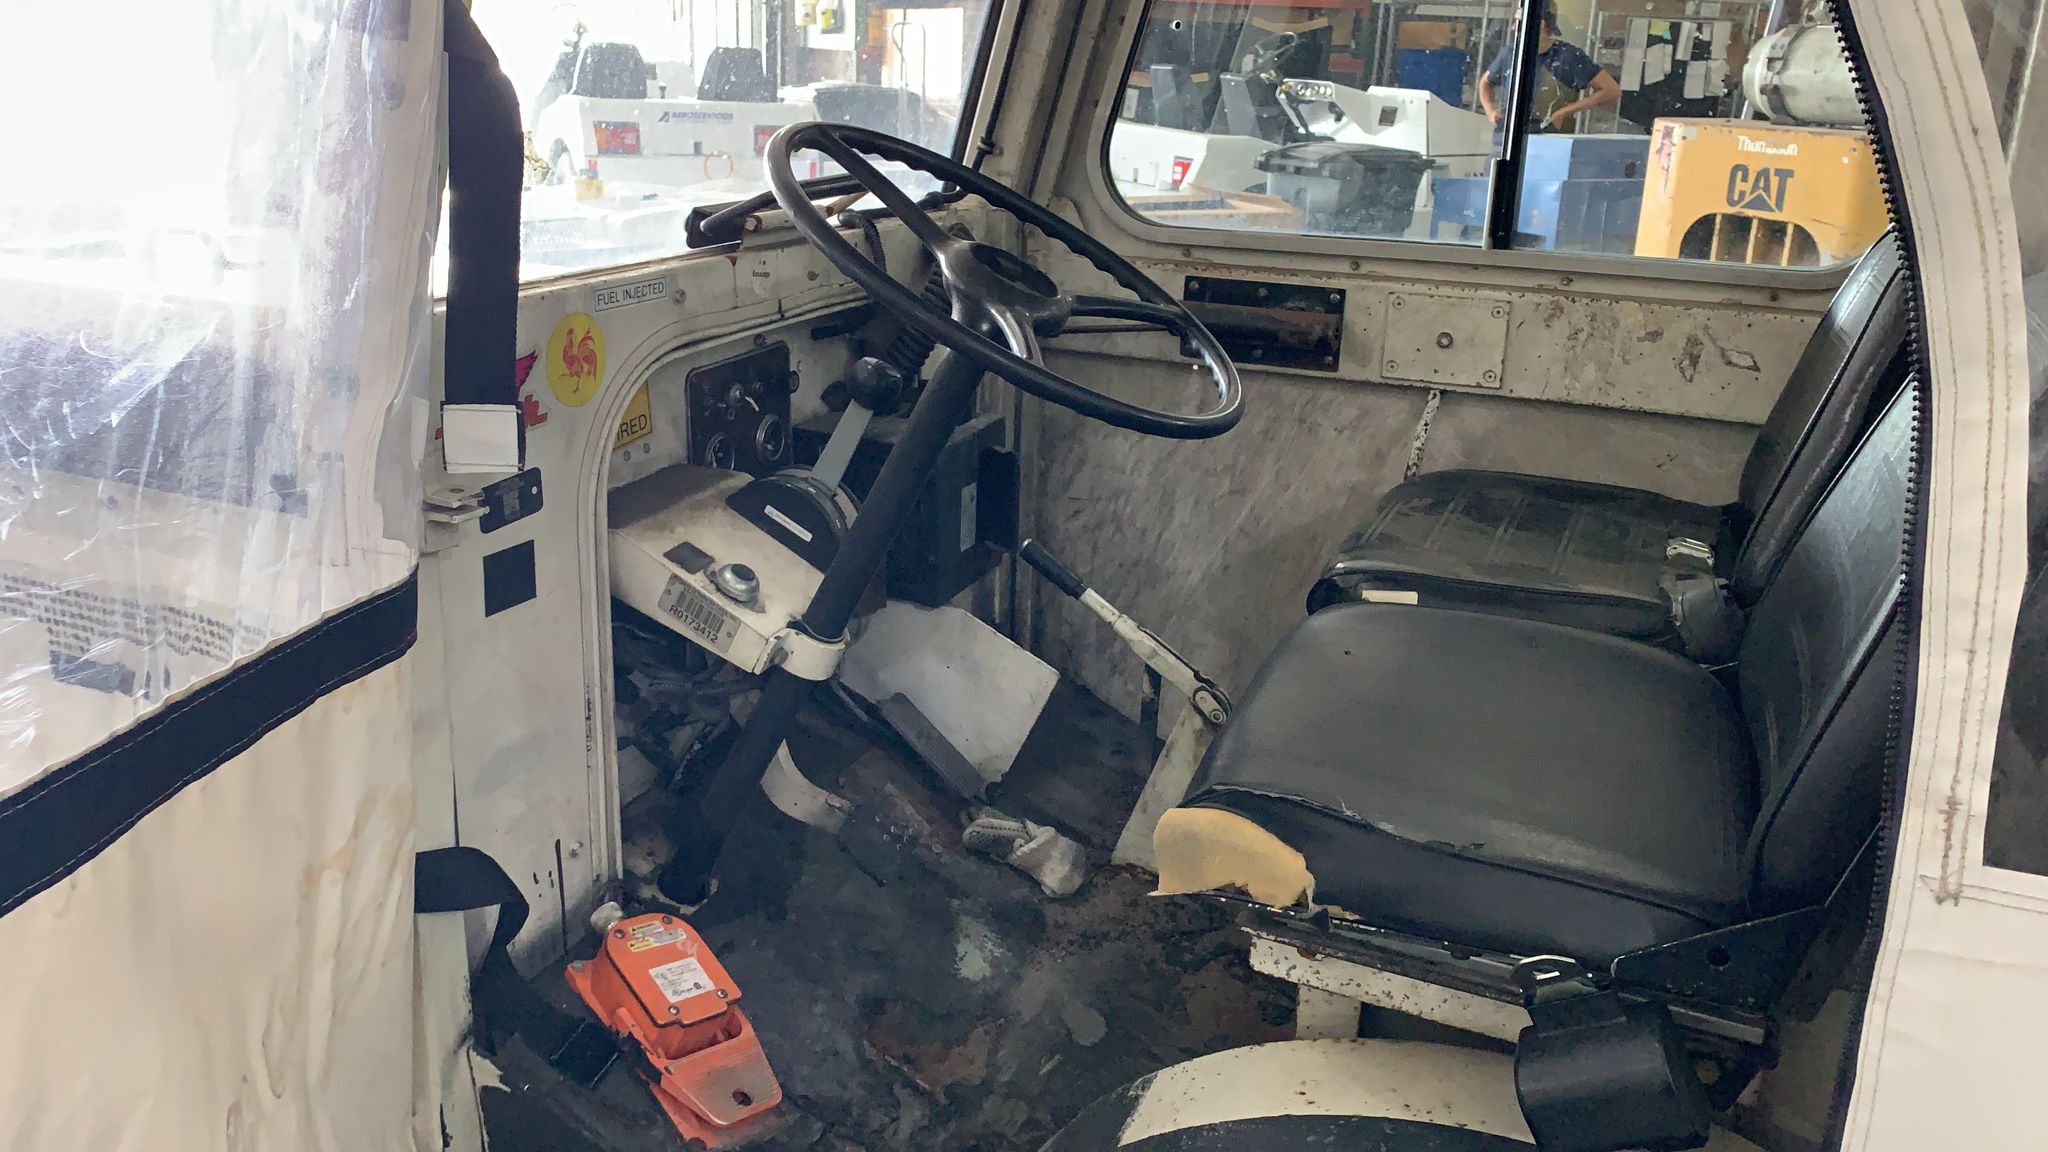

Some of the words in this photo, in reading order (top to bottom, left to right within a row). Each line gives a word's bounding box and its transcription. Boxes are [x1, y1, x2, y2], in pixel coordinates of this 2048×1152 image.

[1726, 163, 1795, 213] CAT
[597, 290, 621, 306] FUEL
[622, 281, 665, 301] INJECTED
[669, 604, 718, 644] R0173412
